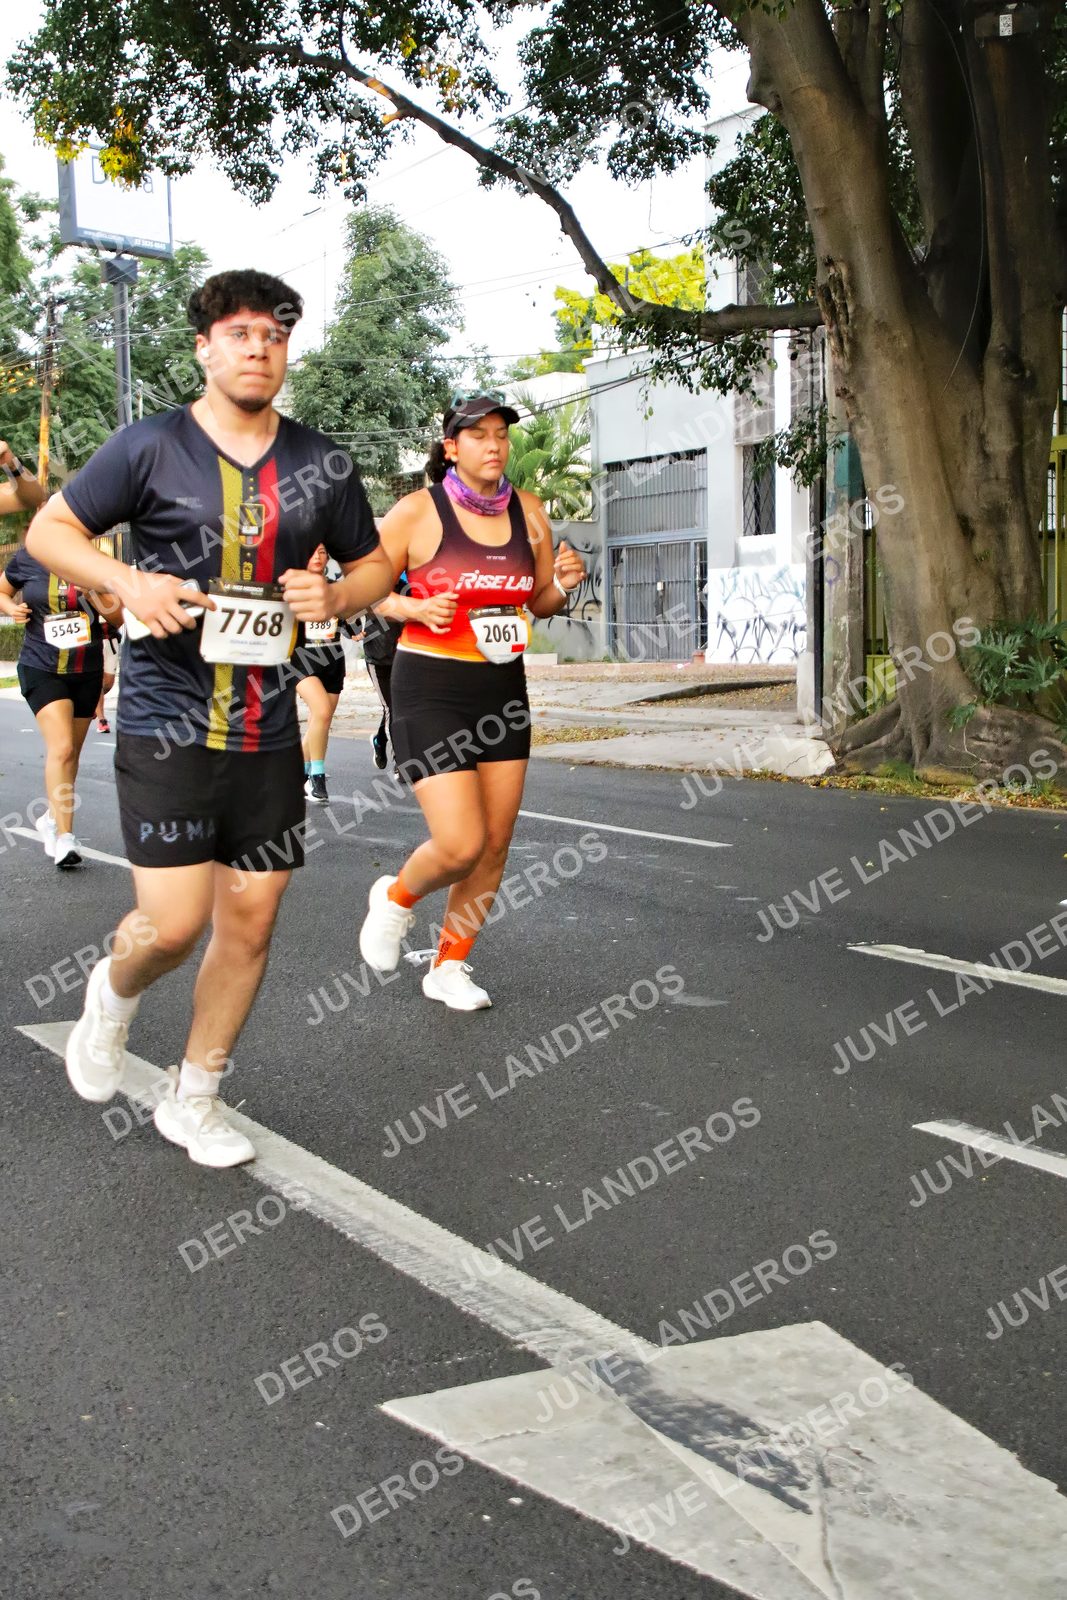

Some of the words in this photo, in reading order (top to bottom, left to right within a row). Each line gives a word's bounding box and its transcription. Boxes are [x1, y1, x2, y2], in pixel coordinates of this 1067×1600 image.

[505, 575, 534, 592] LAB
[51, 622, 81, 638] 5545
[219, 607, 285, 637] 7768
[483, 624, 519, 643] 2061
